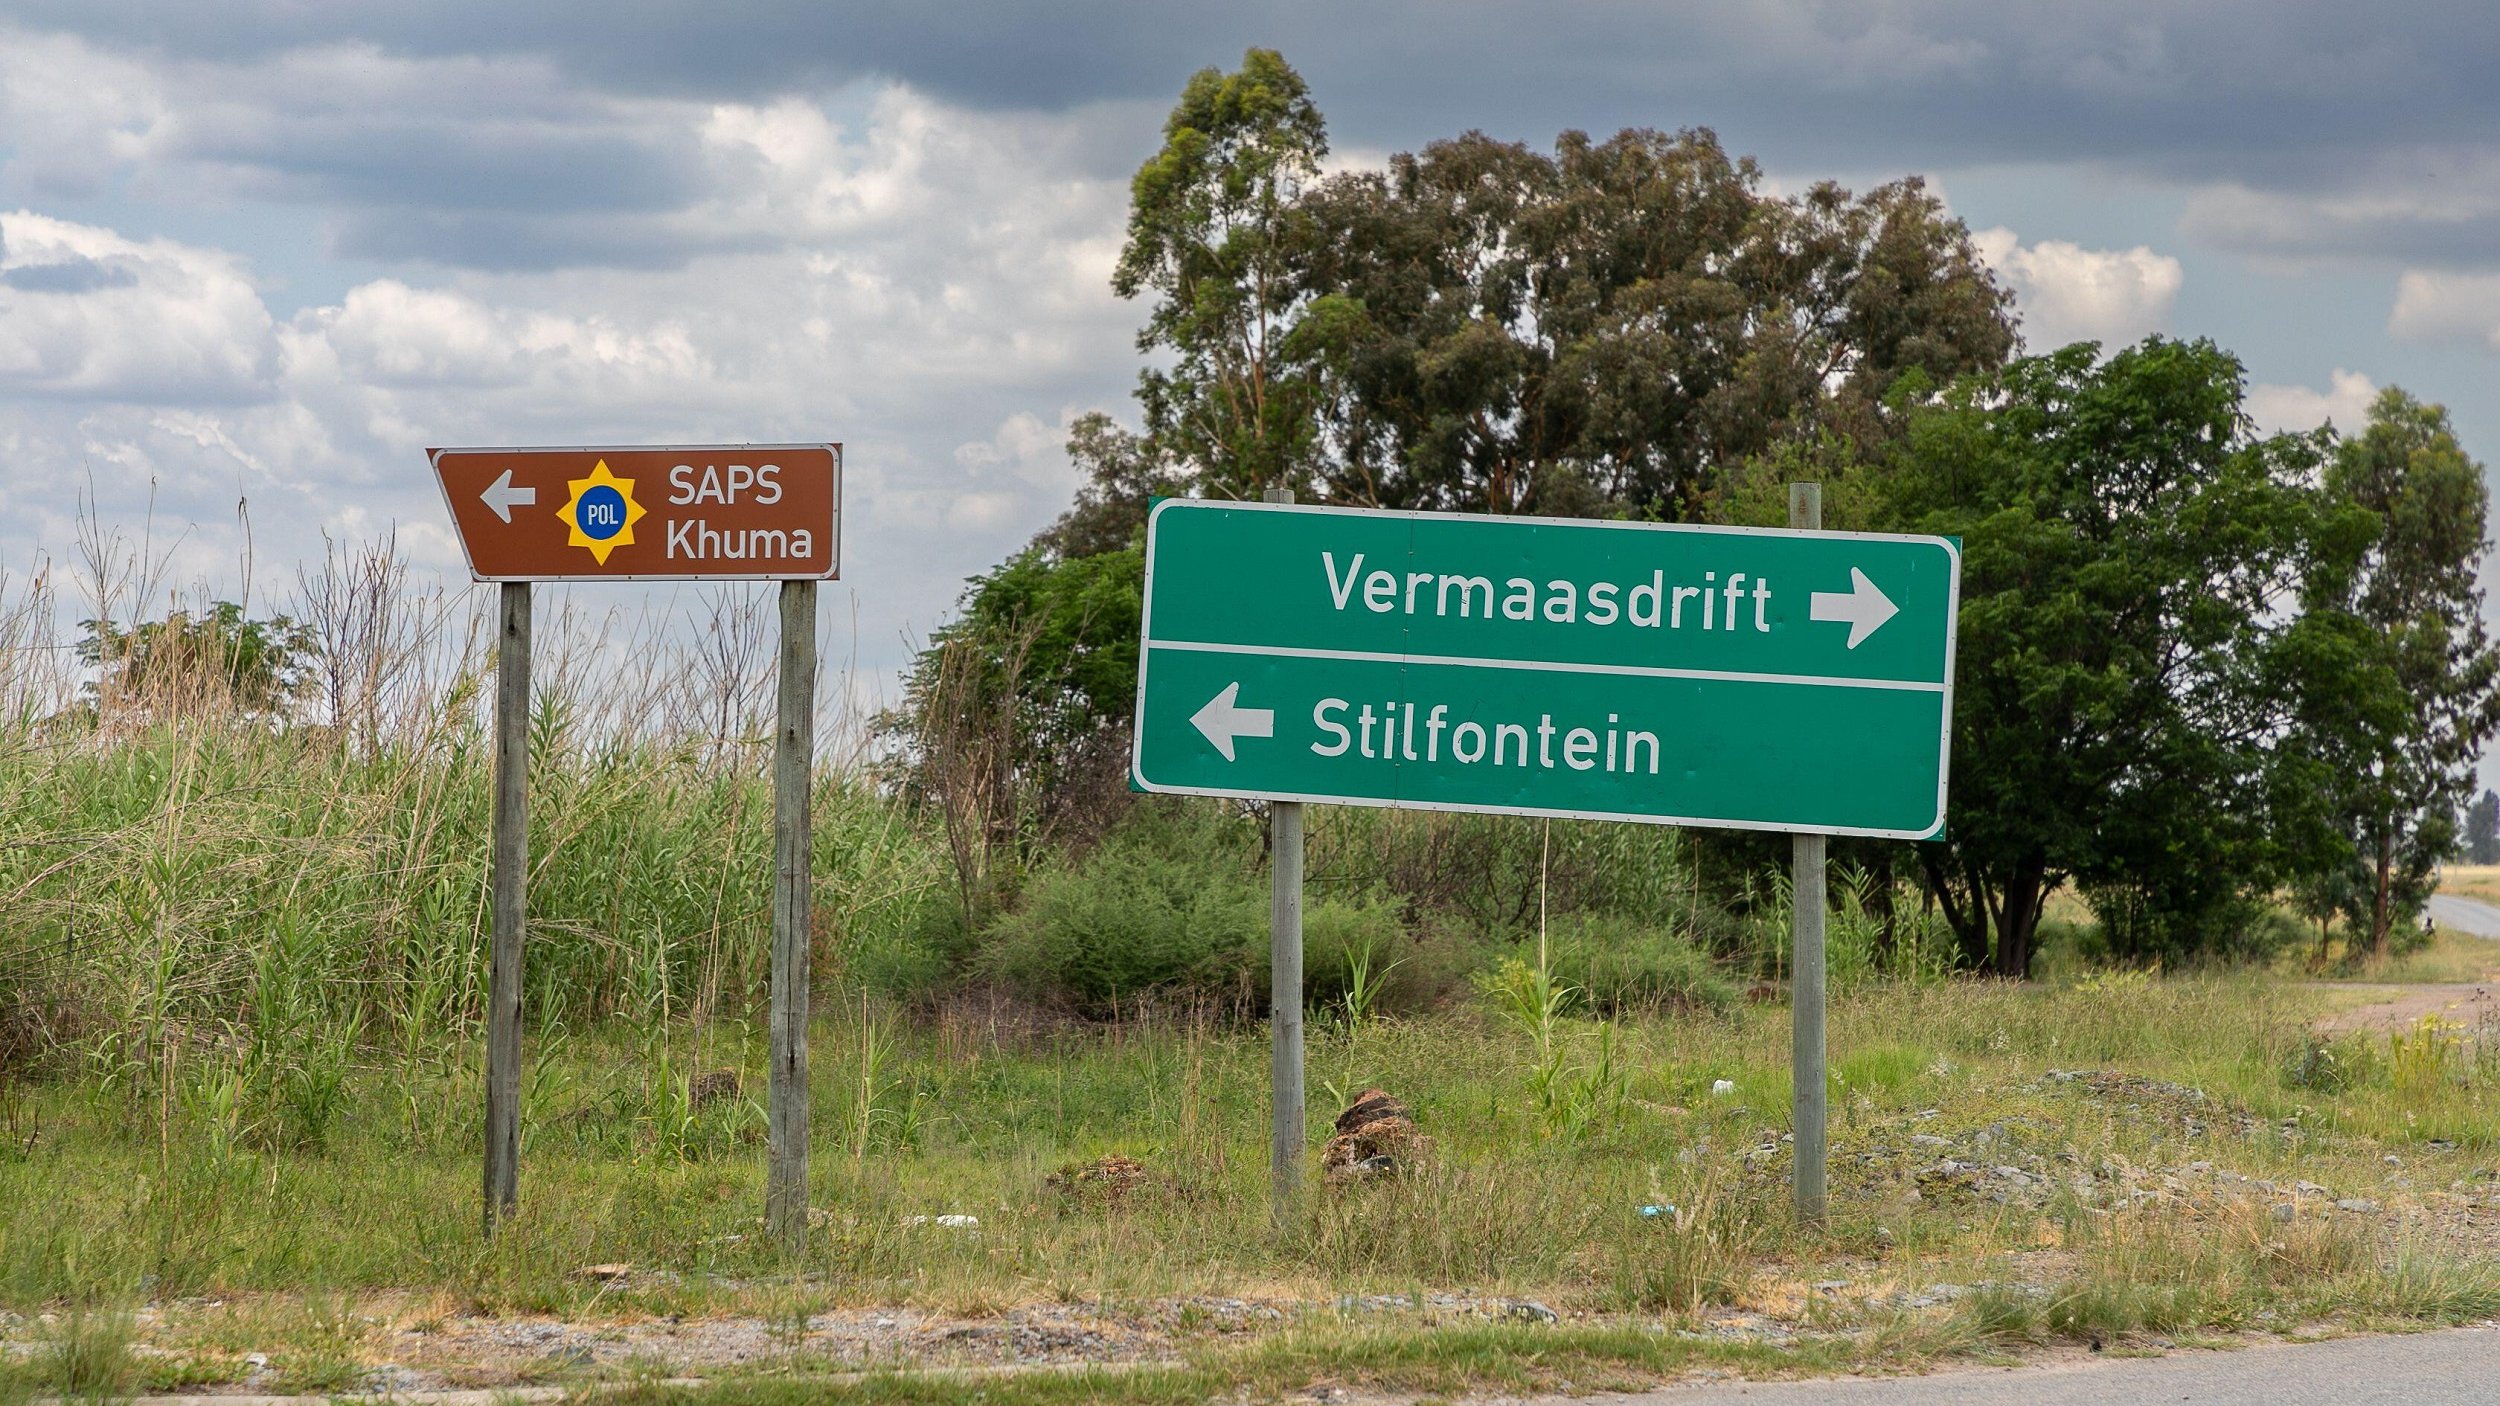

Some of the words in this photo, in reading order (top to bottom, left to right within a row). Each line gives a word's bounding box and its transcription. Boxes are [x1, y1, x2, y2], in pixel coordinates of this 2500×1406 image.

[668, 465, 783, 505] SAPS
[587, 504, 619, 525] POL
[667, 519, 812, 559] Khuma
[1321, 551, 1772, 632] Vermaasdrift
[1310, 698, 1660, 774] Stilfontein
